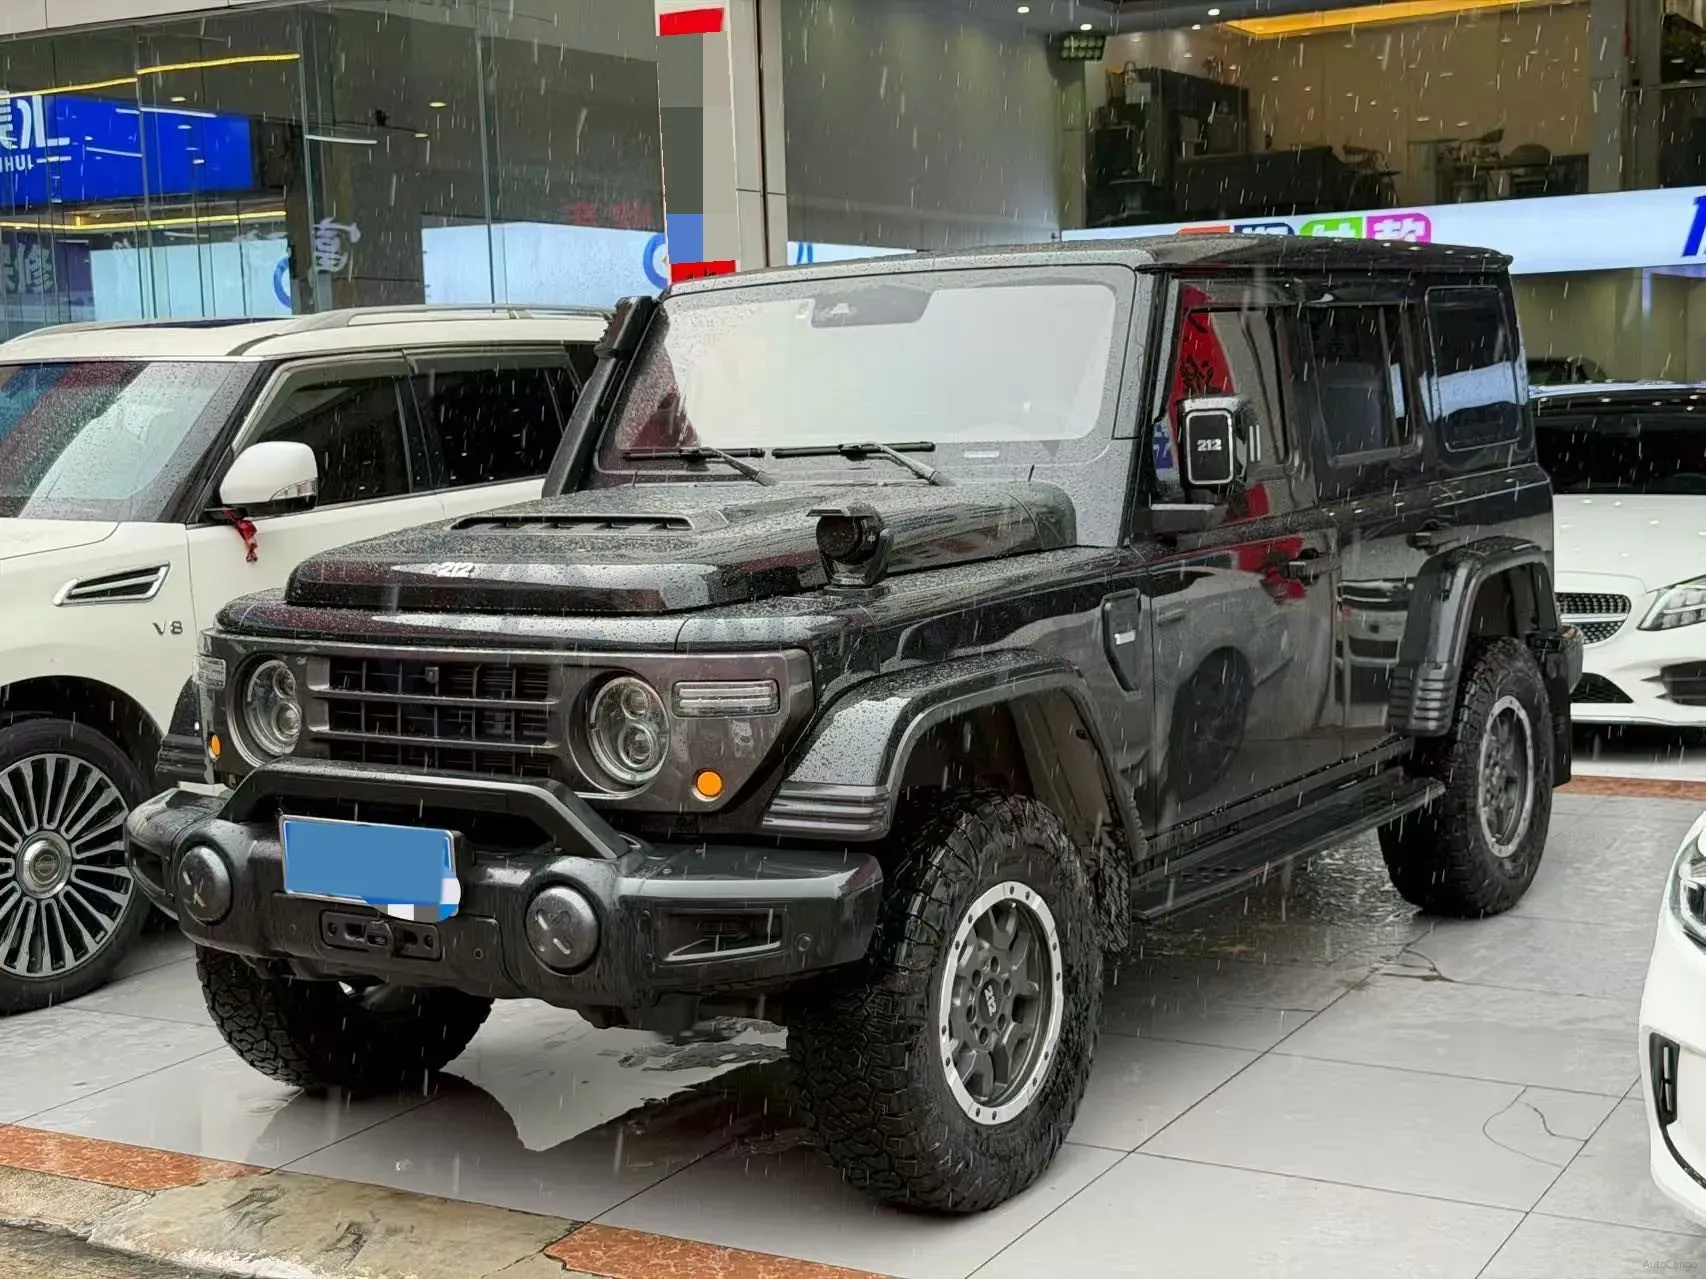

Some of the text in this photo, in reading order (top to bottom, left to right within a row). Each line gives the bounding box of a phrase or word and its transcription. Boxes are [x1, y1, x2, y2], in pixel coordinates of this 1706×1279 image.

[1196, 438, 1222, 452] 212
[152, 619, 184, 636] V8
[984, 984, 997, 1017] 212
